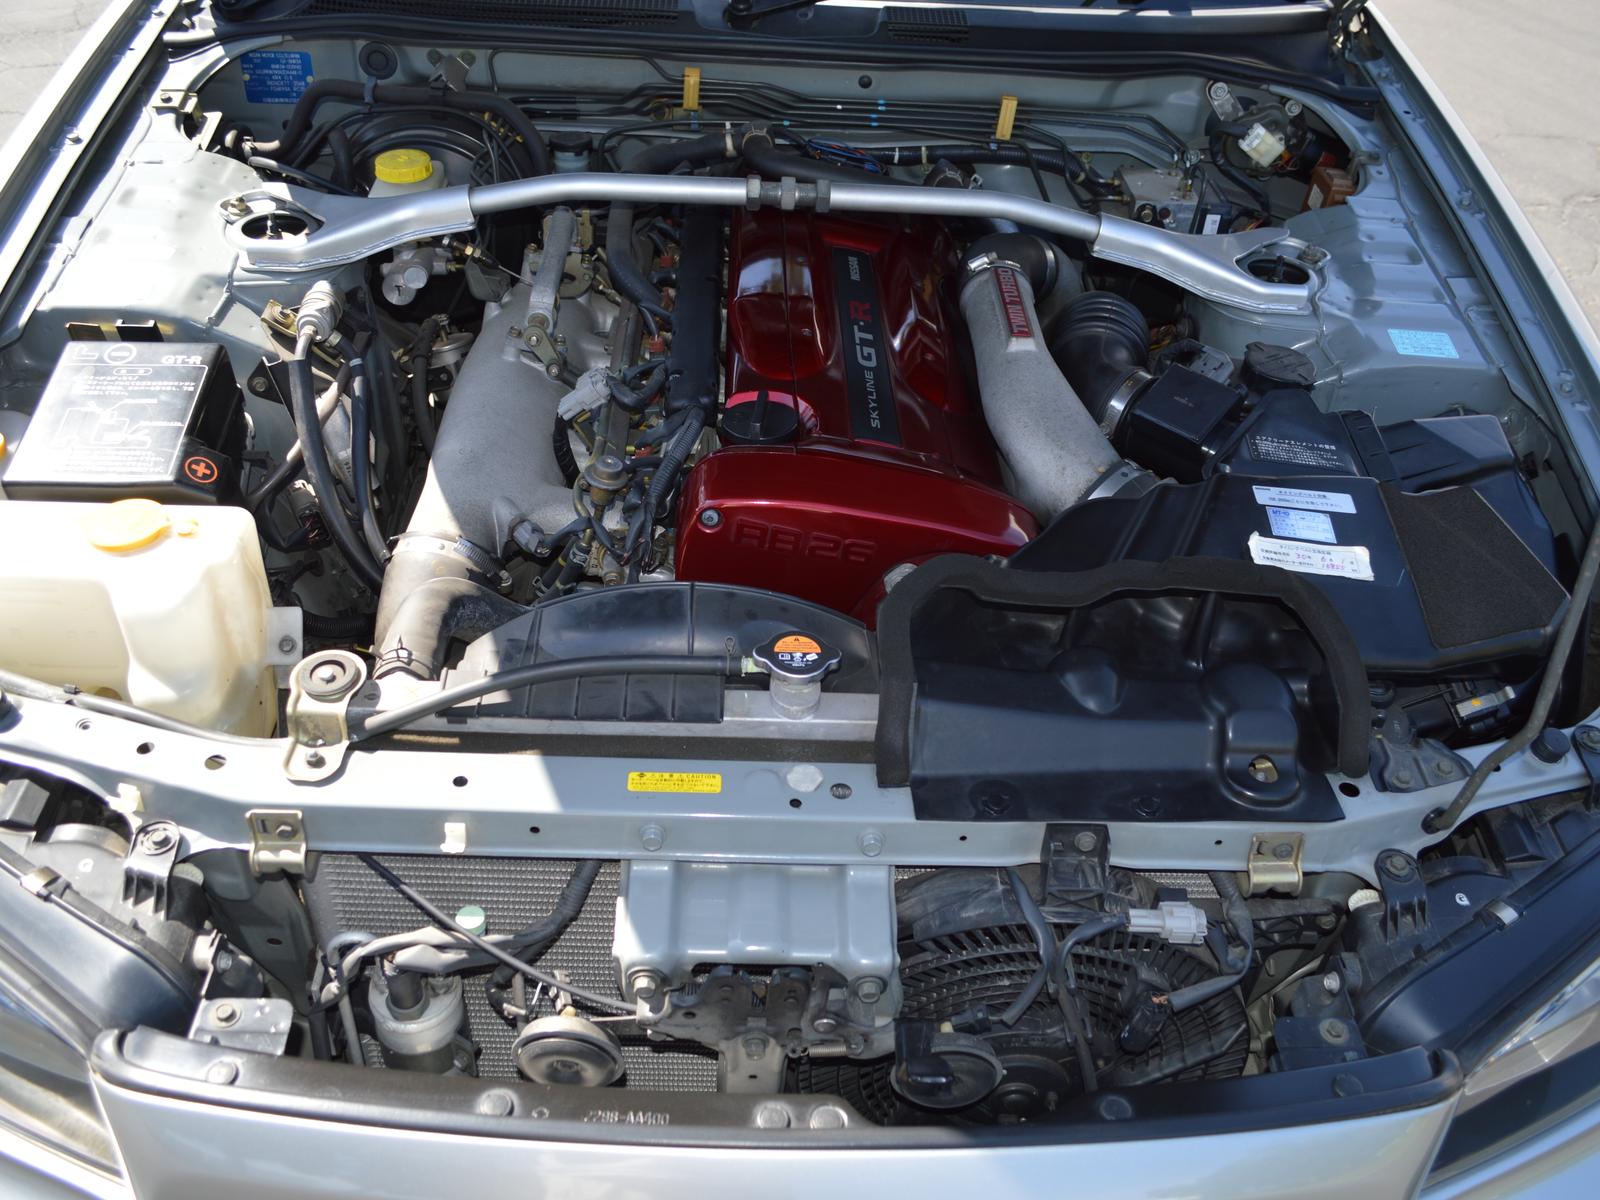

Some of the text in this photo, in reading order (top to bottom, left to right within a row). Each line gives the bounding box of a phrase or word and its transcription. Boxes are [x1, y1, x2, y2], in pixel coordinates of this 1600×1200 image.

[999, 268, 1029, 333] TWIN TURBO
[161, 355, 203, 365] GT-R
[864, 370, 881, 429] SKYLINE
[730, 516, 877, 563] RB26
